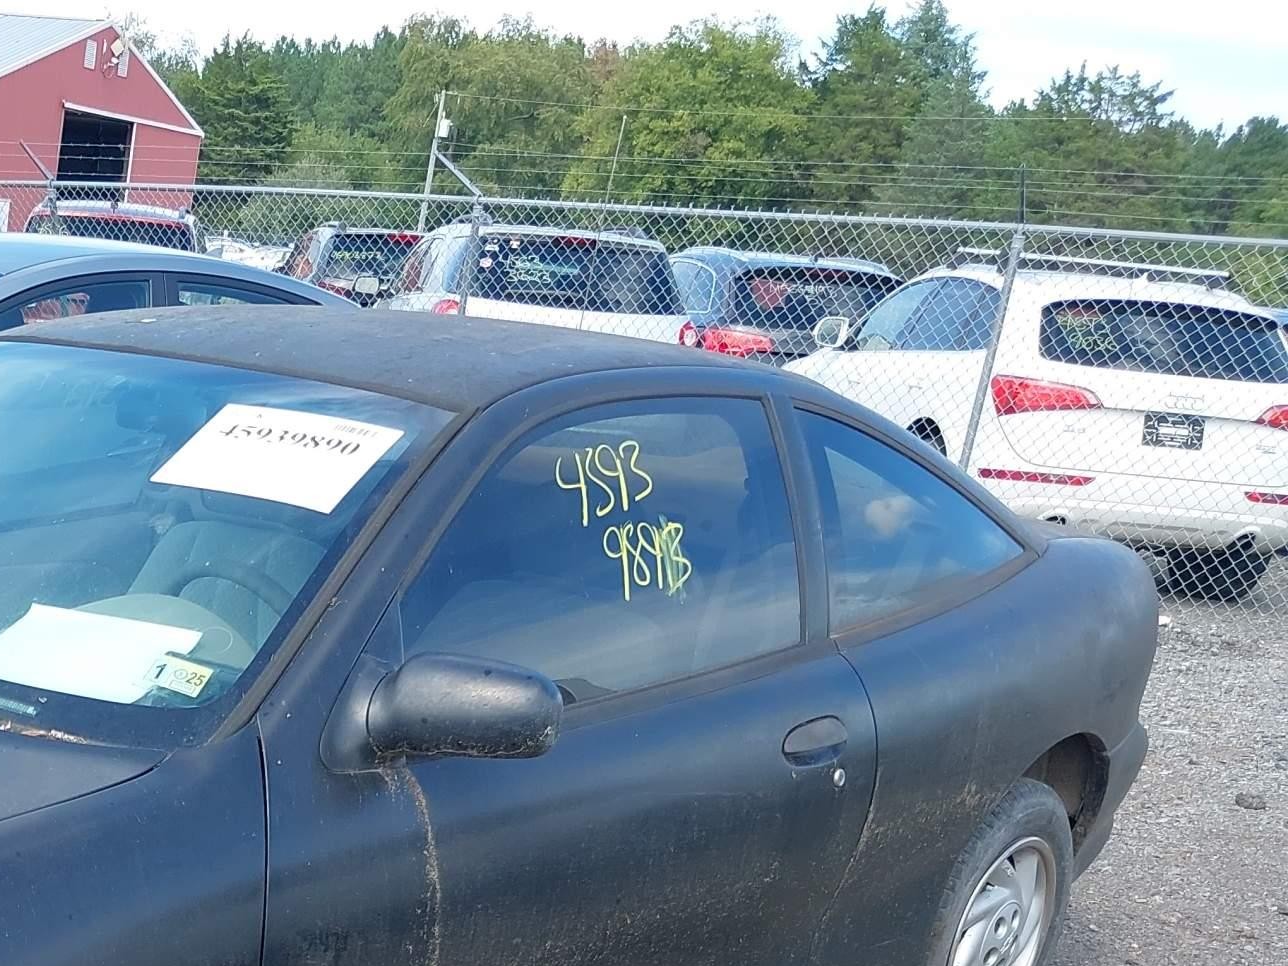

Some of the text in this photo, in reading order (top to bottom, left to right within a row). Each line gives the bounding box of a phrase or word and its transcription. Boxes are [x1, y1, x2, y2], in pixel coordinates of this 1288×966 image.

[220, 424, 361, 456] 45939890
[154, 663, 207, 687] 1 25
